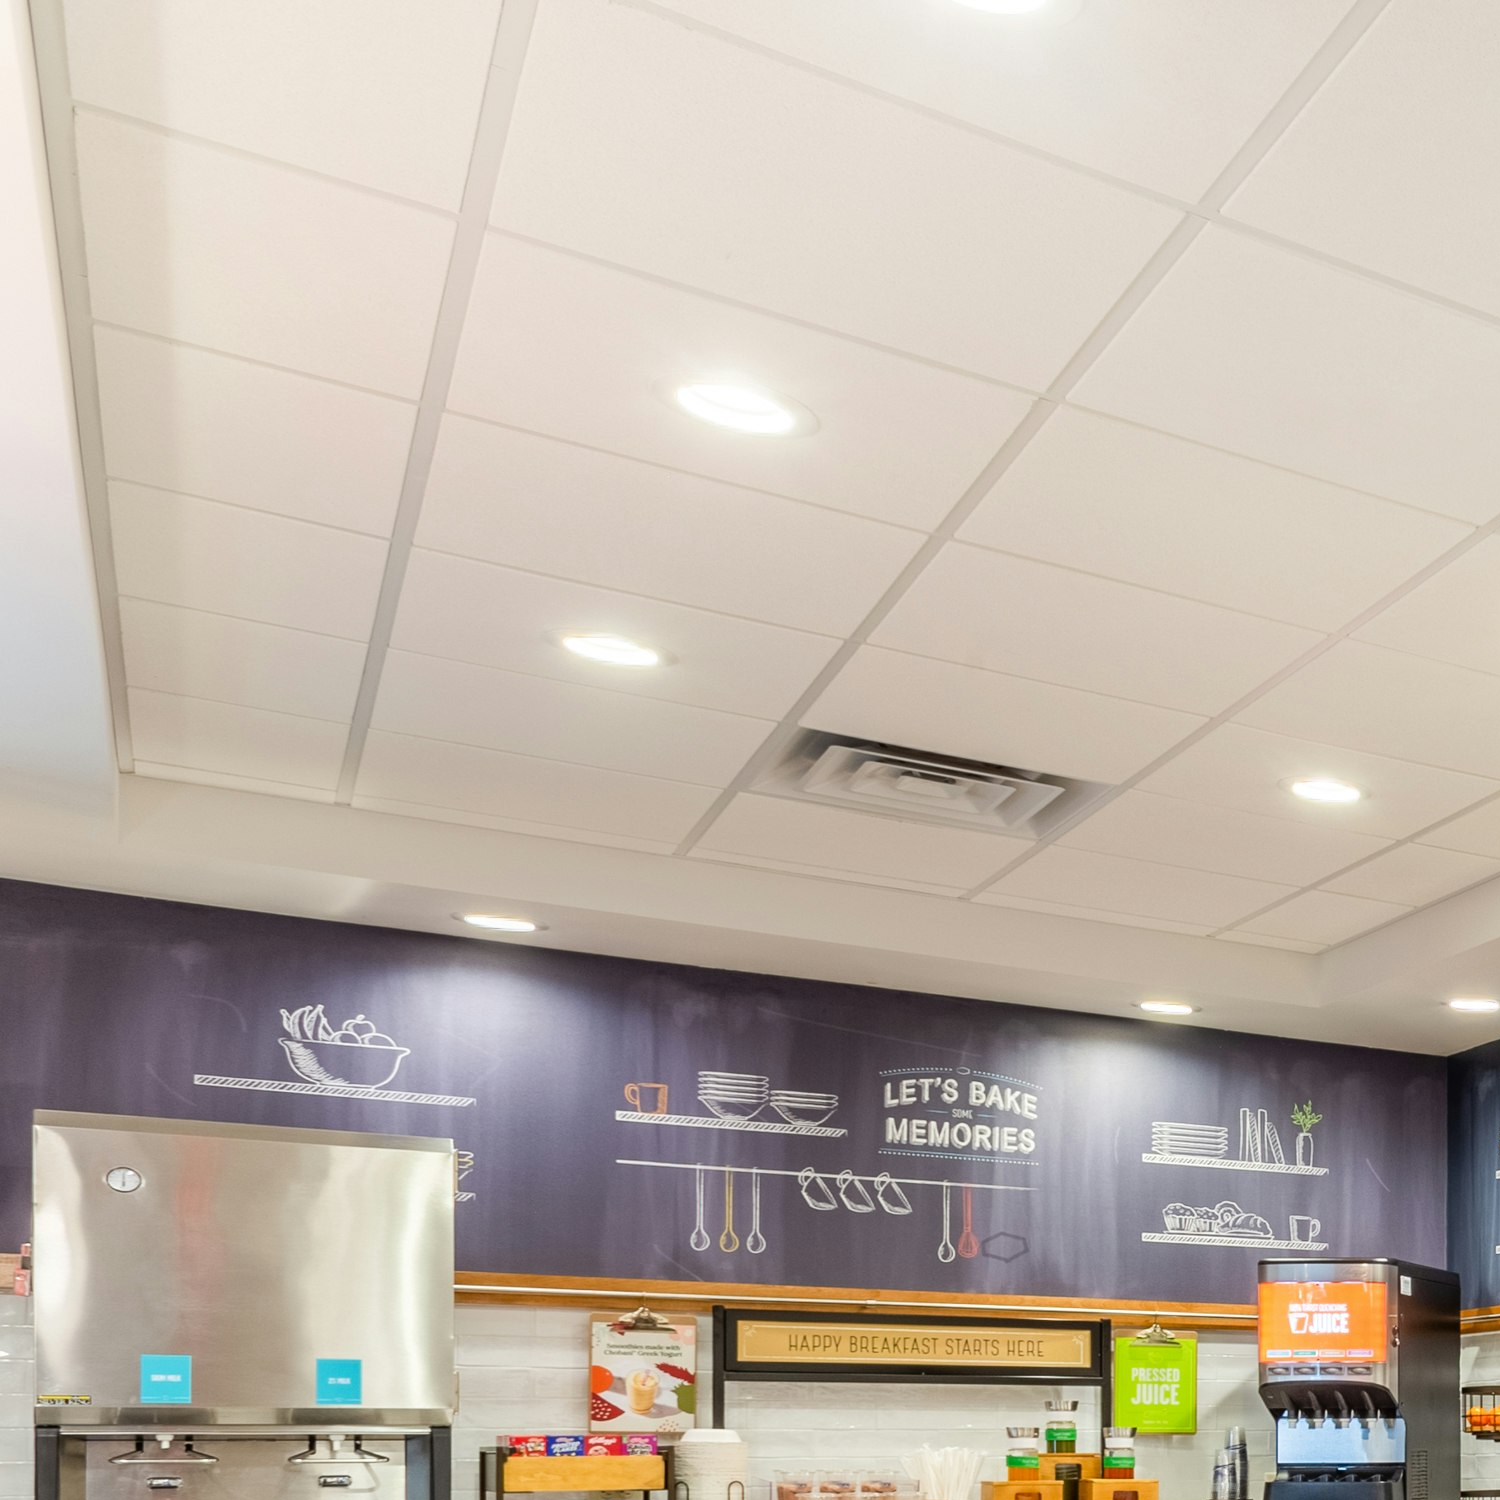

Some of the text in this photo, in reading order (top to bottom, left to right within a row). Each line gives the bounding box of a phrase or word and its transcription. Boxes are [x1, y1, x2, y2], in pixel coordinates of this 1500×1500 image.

[884, 1077, 1038, 1120] LET'S BAKE
[952, 1108, 973, 1119] SOME
[885, 1117, 1036, 1154] MEMORIES
[1309, 1313, 1350, 1334] JUICE
[788, 1334, 1044, 1357] HAPPY BREAKFAST STARTS HERE
[1131, 1367, 1180, 1382] PRESSED
[1131, 1384, 1180, 1405] JUICE
